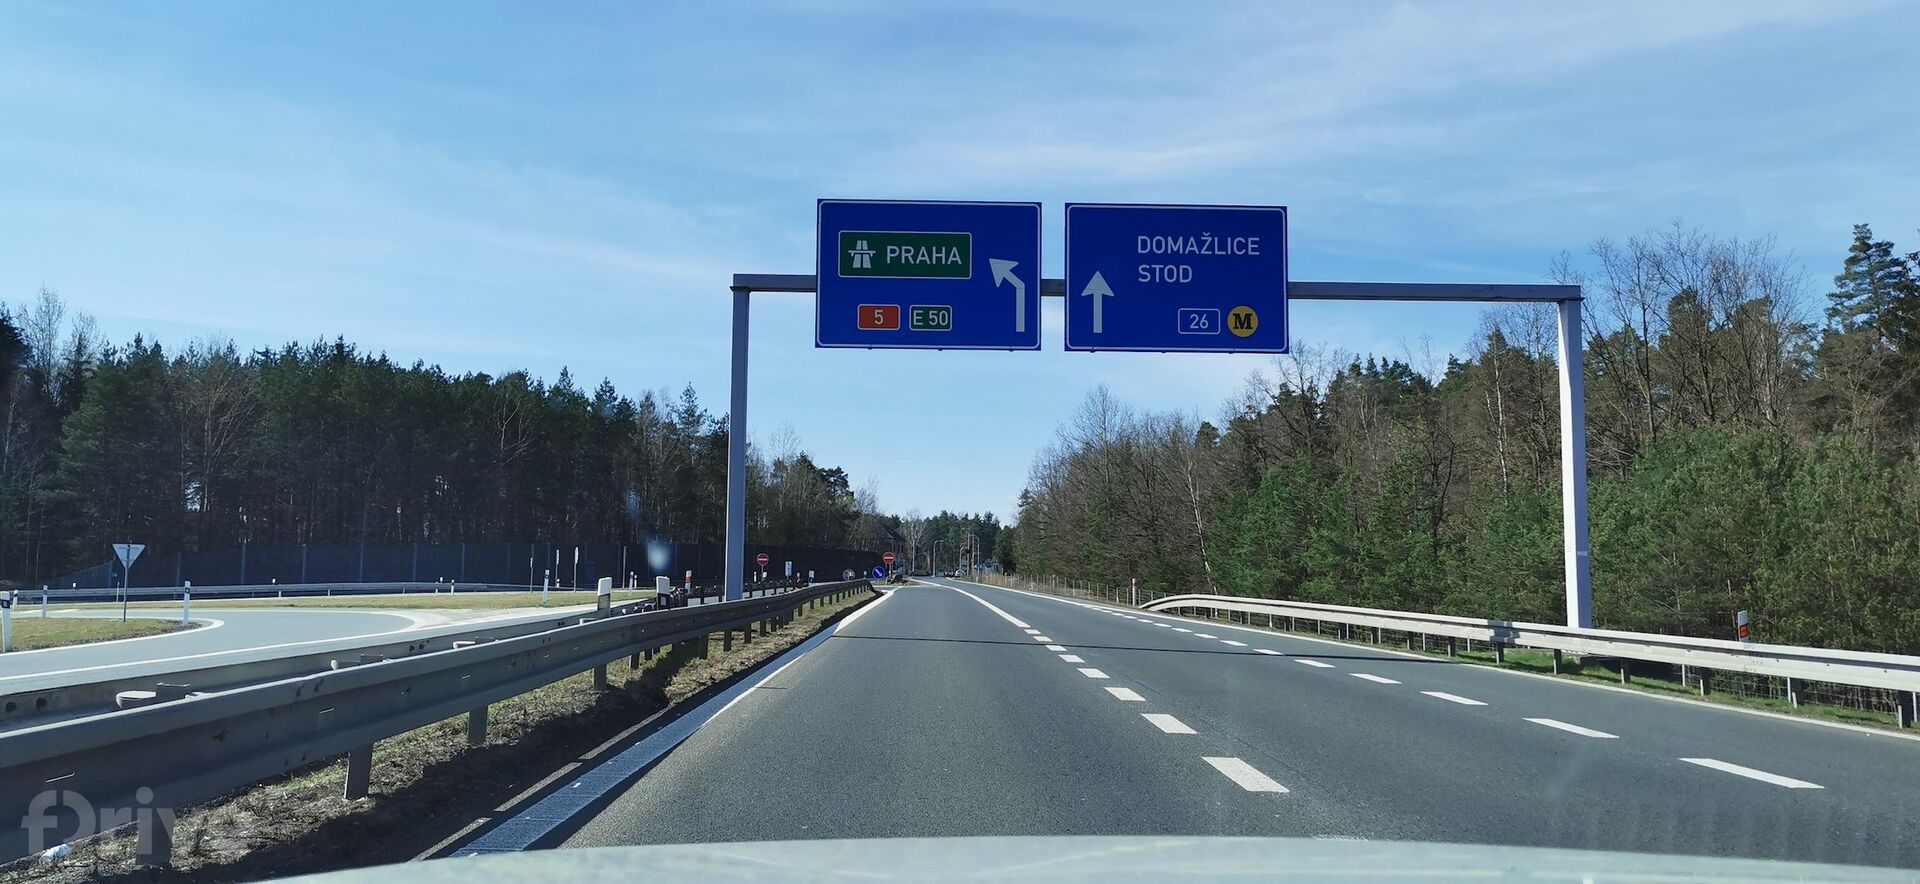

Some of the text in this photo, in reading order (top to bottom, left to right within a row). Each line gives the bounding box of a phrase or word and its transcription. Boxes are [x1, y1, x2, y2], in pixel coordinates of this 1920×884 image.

[1137, 232, 1260, 255] DOMAŽLICE
[887, 246, 962, 264] PRAHA
[1138, 264, 1193, 283] STOD
[874, 309, 884, 325] 5
[913, 310, 948, 326] E 50
[1189, 314, 1209, 329] 26
[1233, 313, 1253, 330] M
